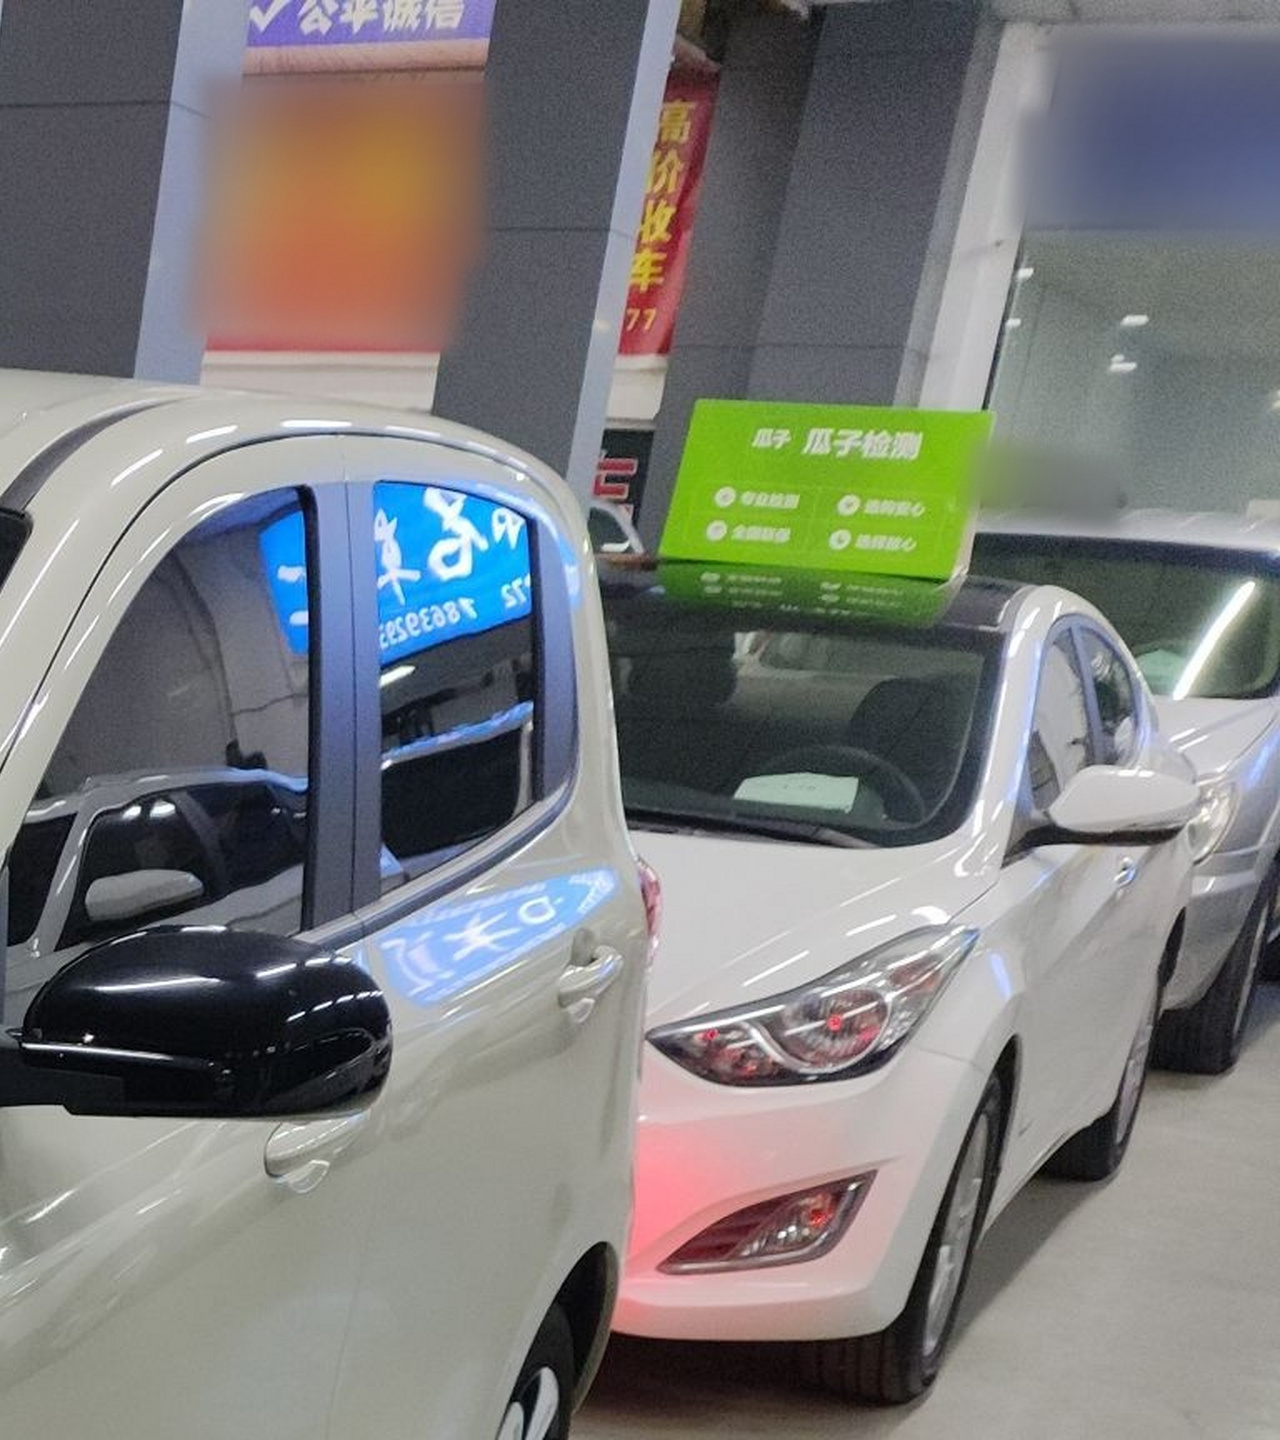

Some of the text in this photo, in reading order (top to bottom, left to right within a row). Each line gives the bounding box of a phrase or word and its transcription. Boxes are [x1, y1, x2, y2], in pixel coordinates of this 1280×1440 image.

[629, 98, 696, 294] 高价收车
[803, 427, 923, 461] 瓜子检测
